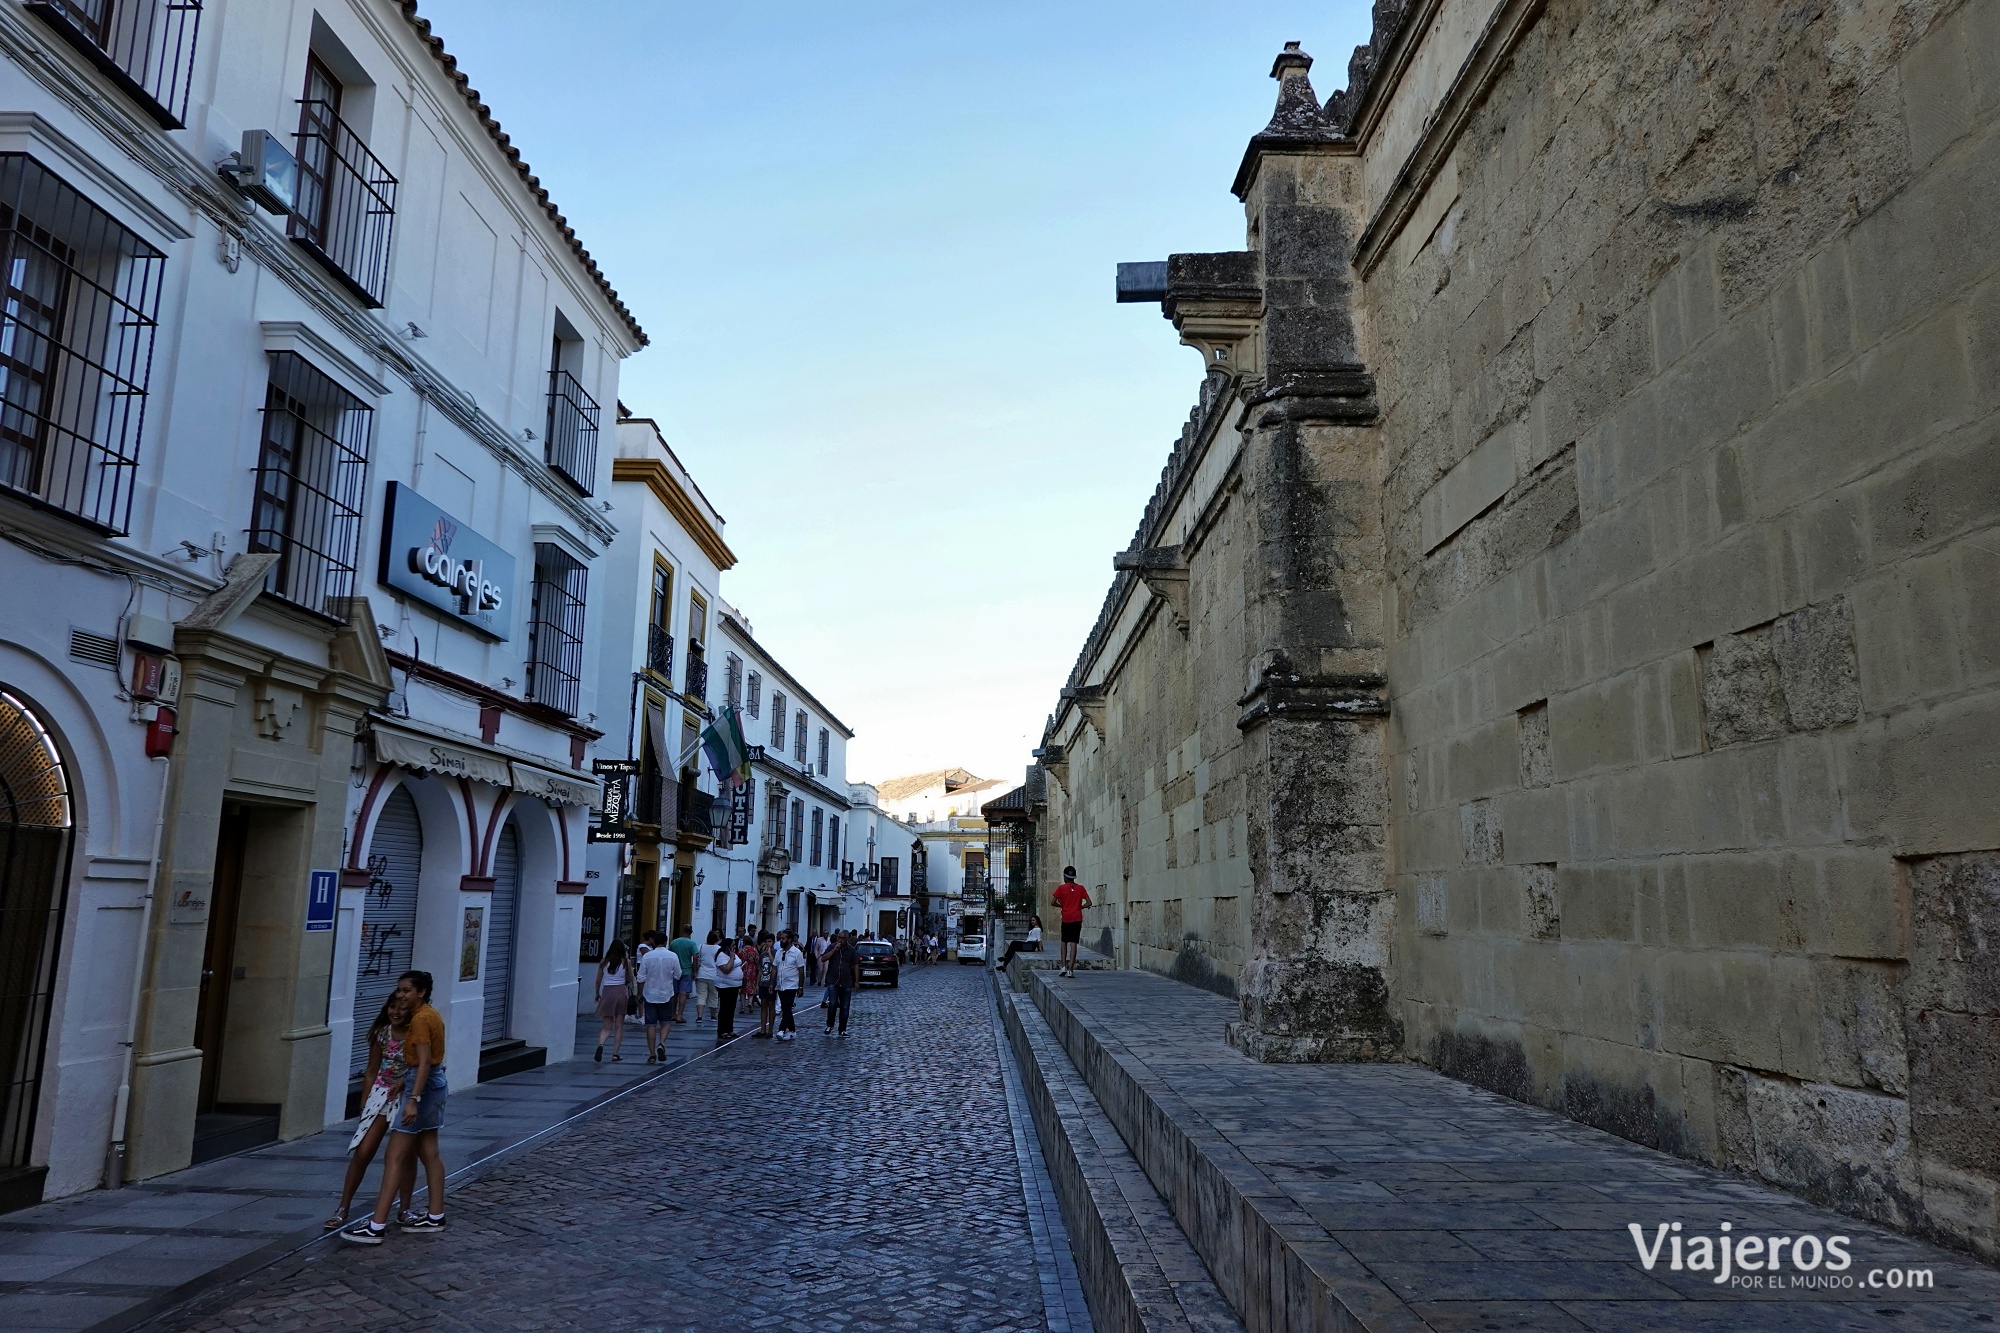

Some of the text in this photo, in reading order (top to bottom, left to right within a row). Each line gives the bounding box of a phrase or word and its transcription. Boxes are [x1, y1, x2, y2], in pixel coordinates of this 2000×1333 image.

[422, 547, 503, 612] caireles
[159, 724, 173, 732] FUEGO
[747, 747, 761, 760] SA
[596, 762, 636, 772] Vinos y Tapas
[604, 787, 614, 814] BODEGAS
[608, 778, 622, 824] MEZQUITA
[732, 781, 747, 843] OTEL
[585, 870, 600, 879] ES
[315, 876, 331, 904] H
[588, 939, 599, 957] 60
